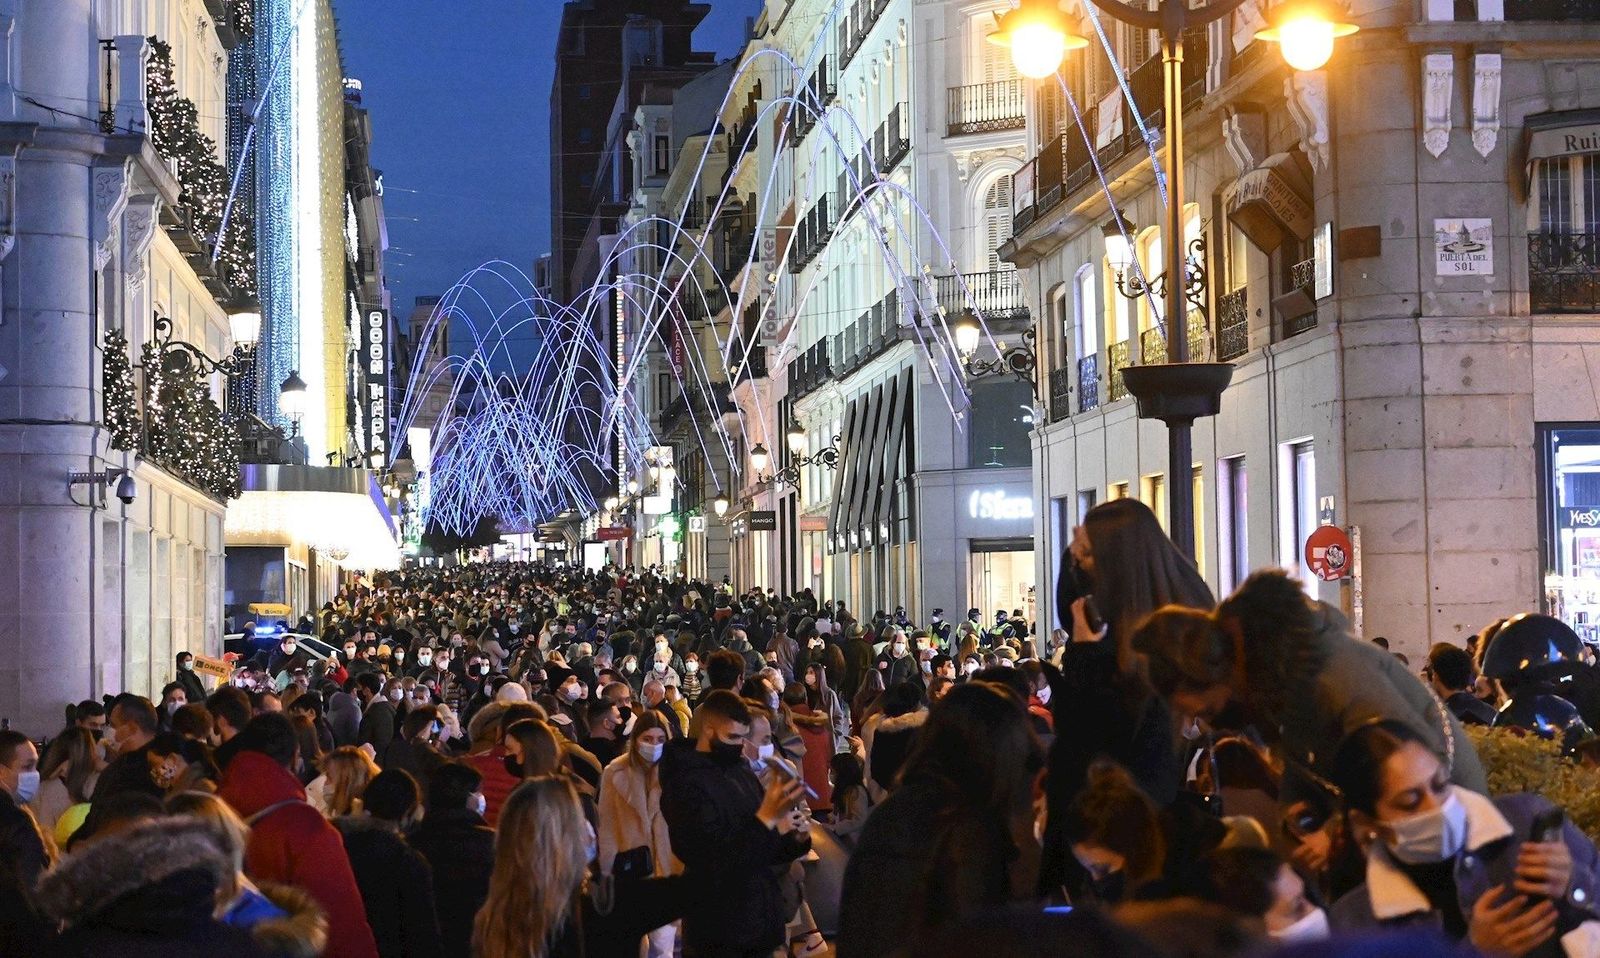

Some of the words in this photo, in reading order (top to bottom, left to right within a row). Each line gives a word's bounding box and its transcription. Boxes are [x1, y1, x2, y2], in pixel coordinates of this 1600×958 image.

[1565, 132, 1600, 152] Rui
[1440, 252, 1472, 262] PUERTA
[1473, 254, 1488, 262] DEL
[1454, 262, 1475, 272] SOL
[369, 311, 384, 375] 2000
[368, 383, 385, 467] PORT
[204, 662, 226, 674] ONCE
